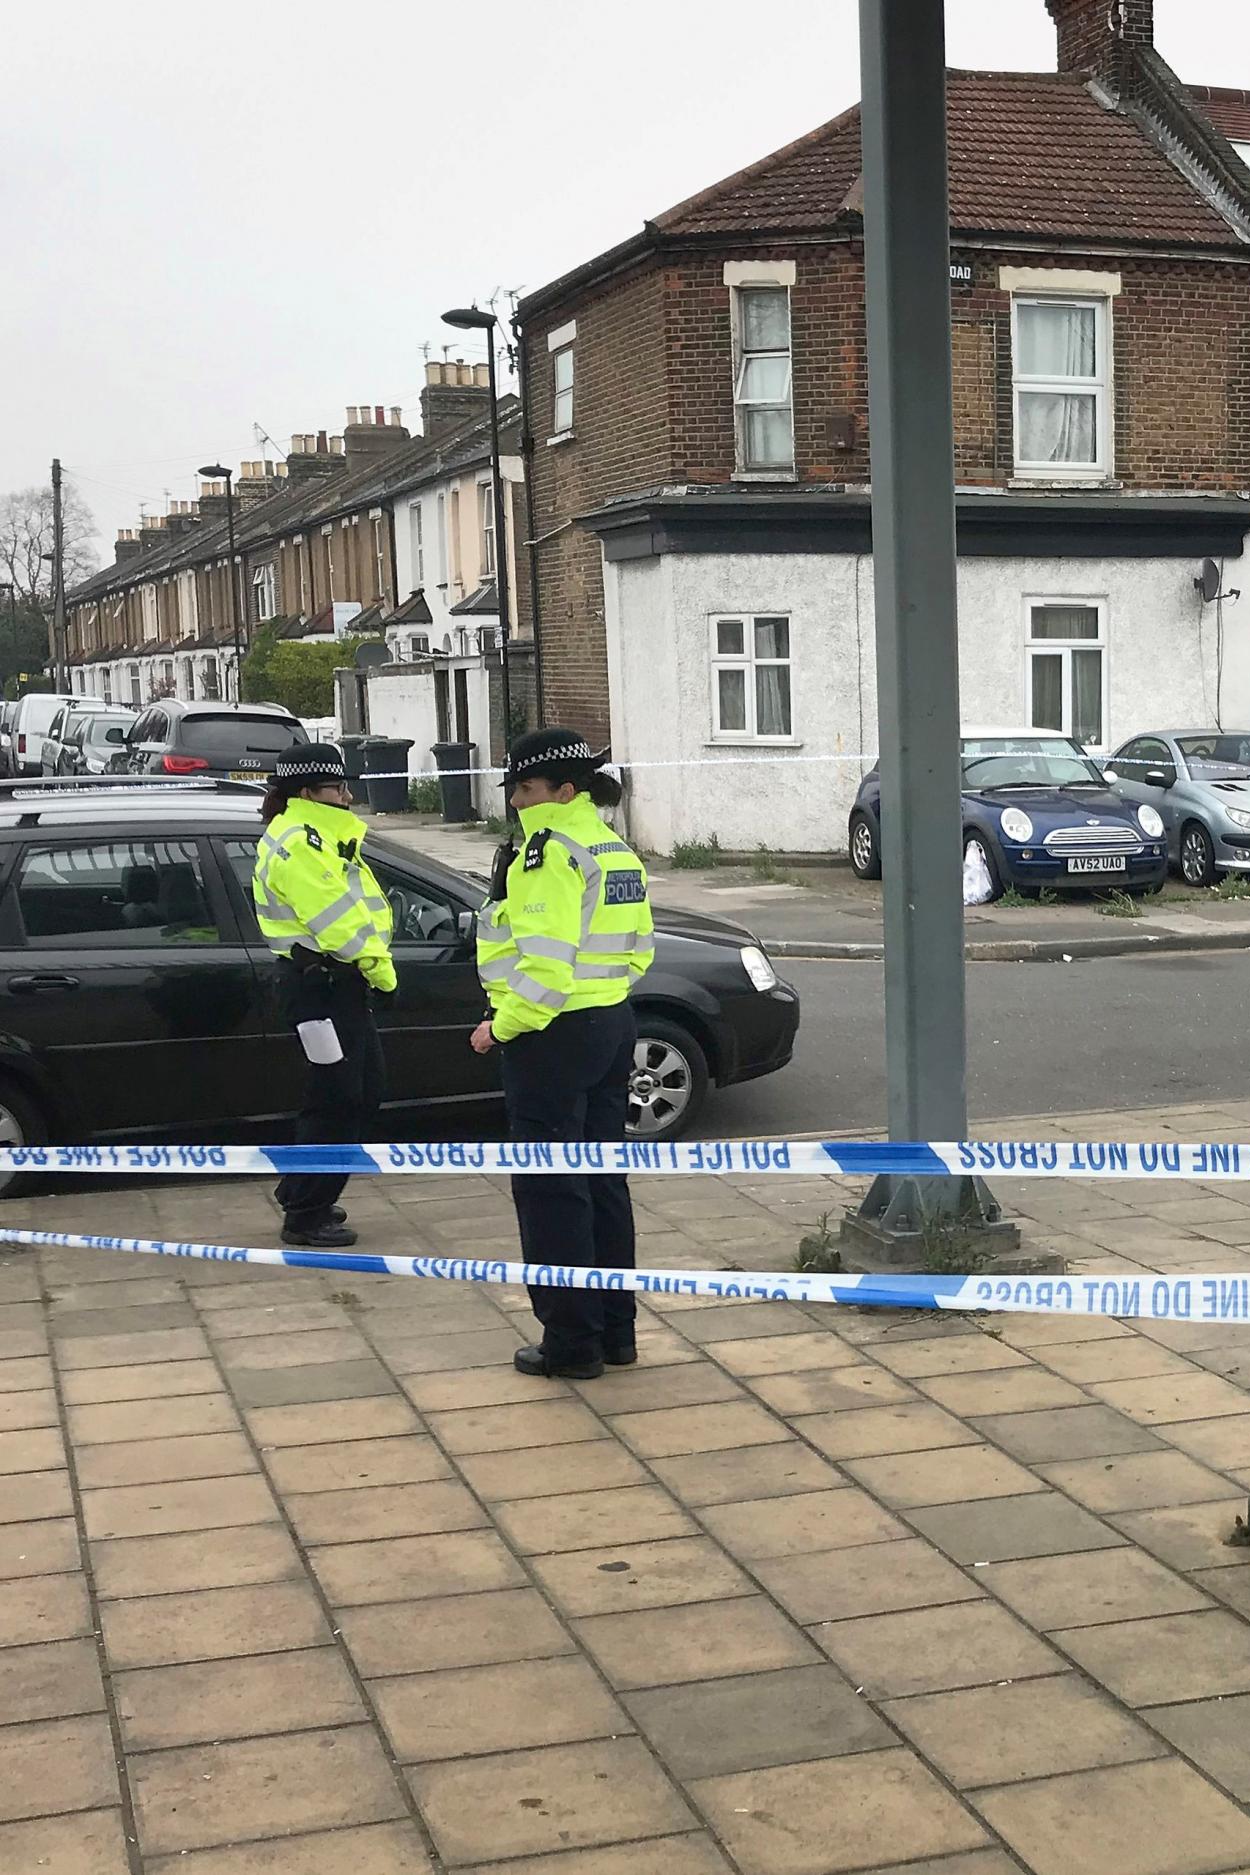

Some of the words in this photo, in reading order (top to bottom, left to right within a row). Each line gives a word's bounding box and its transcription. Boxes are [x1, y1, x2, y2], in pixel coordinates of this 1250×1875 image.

[950, 265, 971, 279] OAD
[1073, 858, 1100, 870] AV52
[390, 1143, 484, 1168] CROSS
[496, 1143, 550, 1168] NOT
[689, 1141, 791, 1170] POLICE
[960, 1141, 1057, 1170] CROSS
[1069, 1143, 1128, 1171] NOT
[1140, 1143, 1180, 1172] DO
